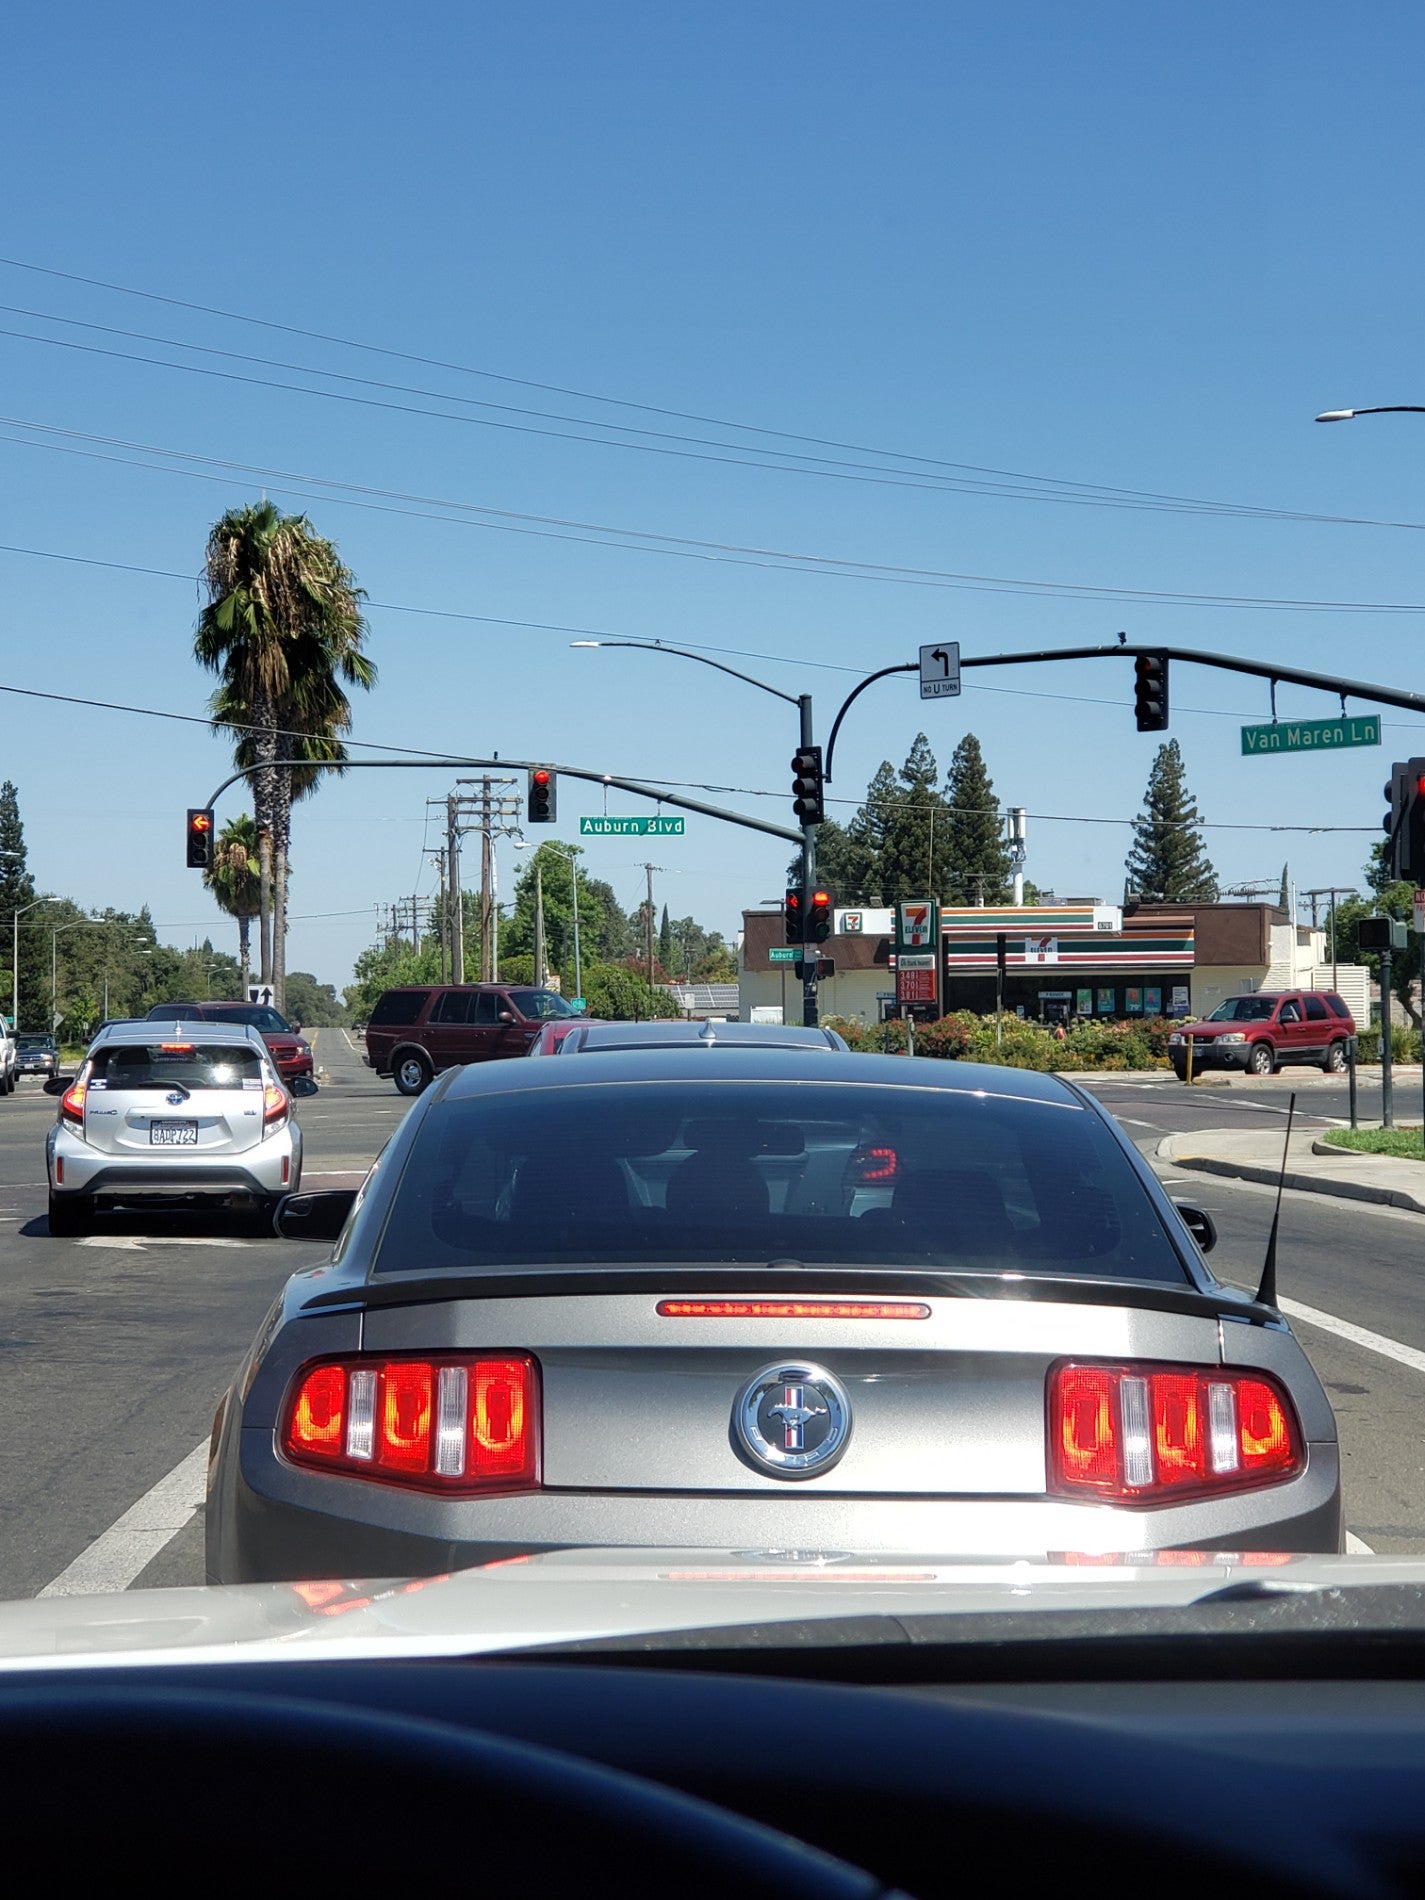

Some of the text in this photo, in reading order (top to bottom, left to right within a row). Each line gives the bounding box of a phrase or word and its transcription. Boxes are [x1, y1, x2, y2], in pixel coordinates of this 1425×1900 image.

[923, 683, 957, 694] NO U TURN
[1246, 722, 1375, 749] Van Maren Ln
[583, 819, 682, 832] Auburn Blvd
